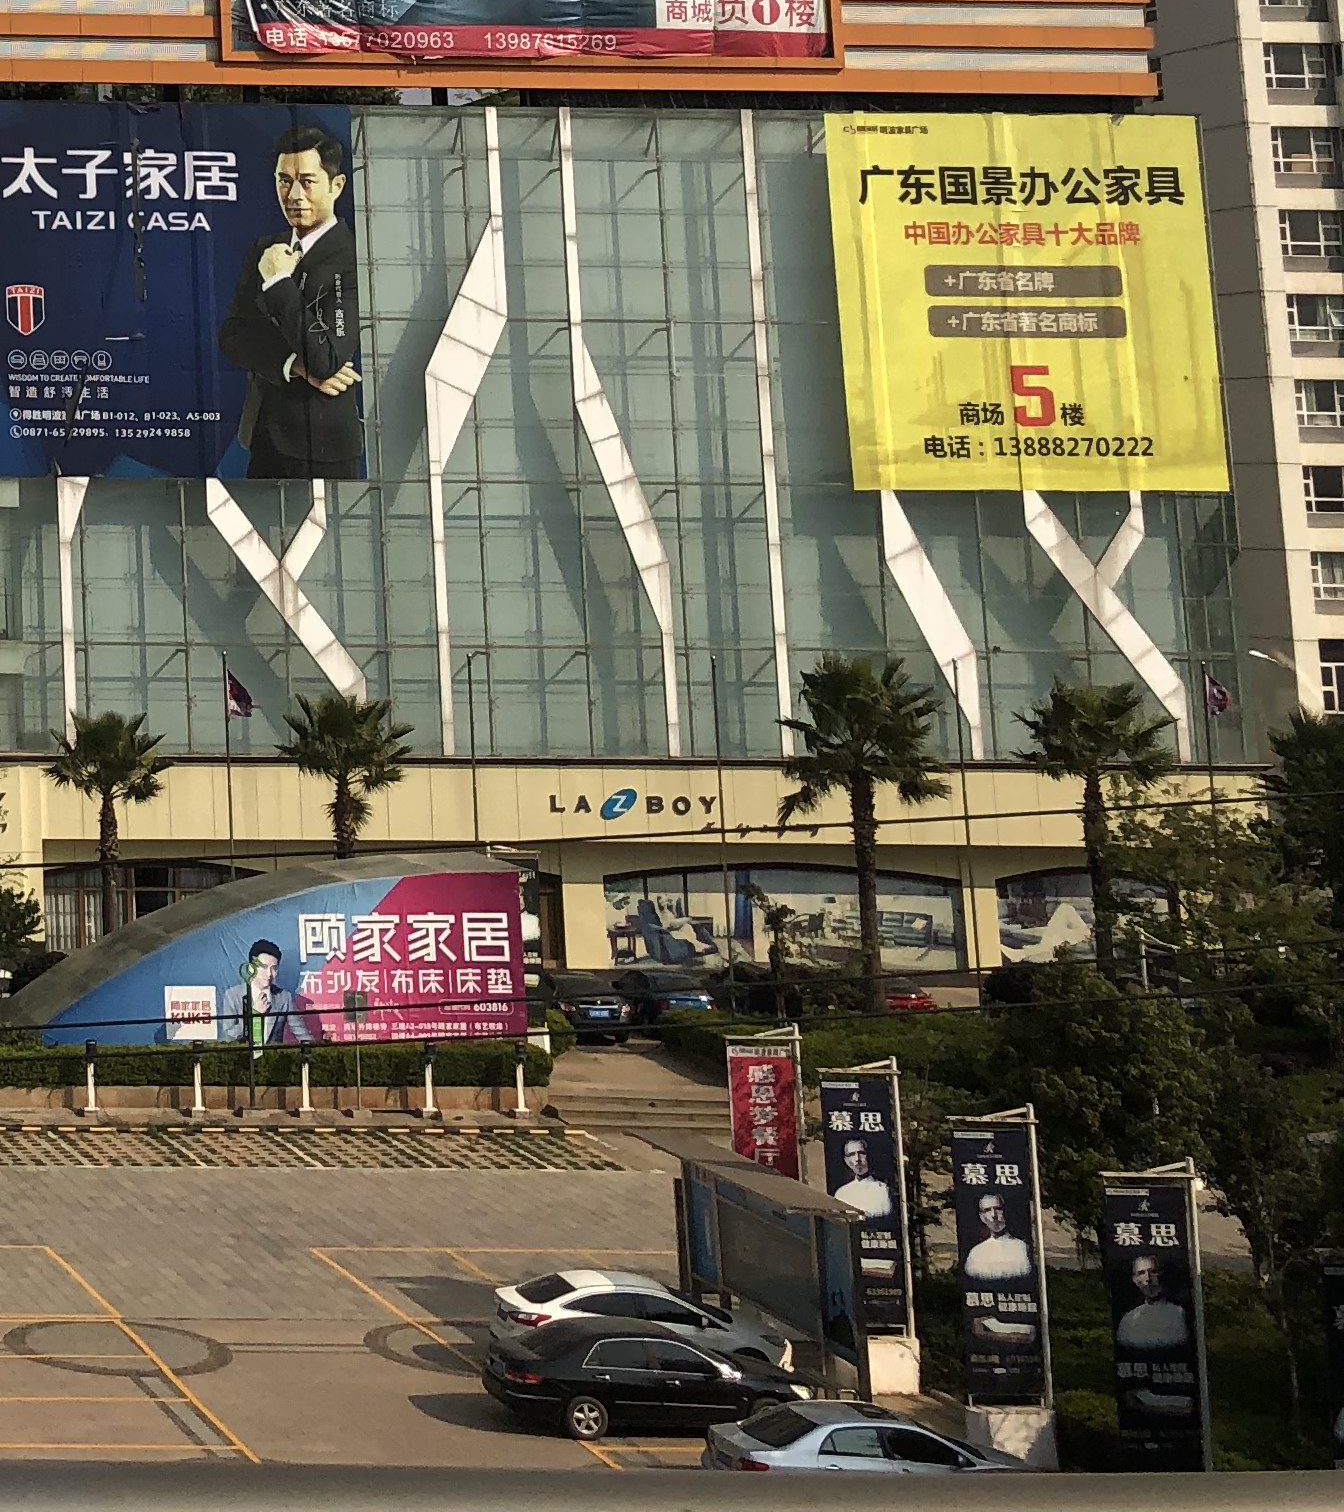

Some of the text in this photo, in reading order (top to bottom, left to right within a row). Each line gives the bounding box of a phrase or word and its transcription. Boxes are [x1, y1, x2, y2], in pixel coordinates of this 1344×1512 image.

[0, 146, 239, 202] 太子家居
[858, 164, 1186, 207] 广东国景办公家具
[31, 210, 212, 232] TAIZI CASA
[903, 221, 1141, 247] 中国办公家具十大品牌
[8, 373, 39, 382] WISDOM
[40, 374, 50, 382] TO
[79, 374, 133, 384] OMFORTABLE
[298, 911, 512, 965] 顾家家居
[299, 969, 513, 994] 布沙发 布床 床垫
[473, 1003, 509, 1013] 603816
[828, 1109, 885, 1134] 慕思
[961, 1161, 1024, 1186] 慕思
[1113, 1221, 1180, 1248] 慕思
